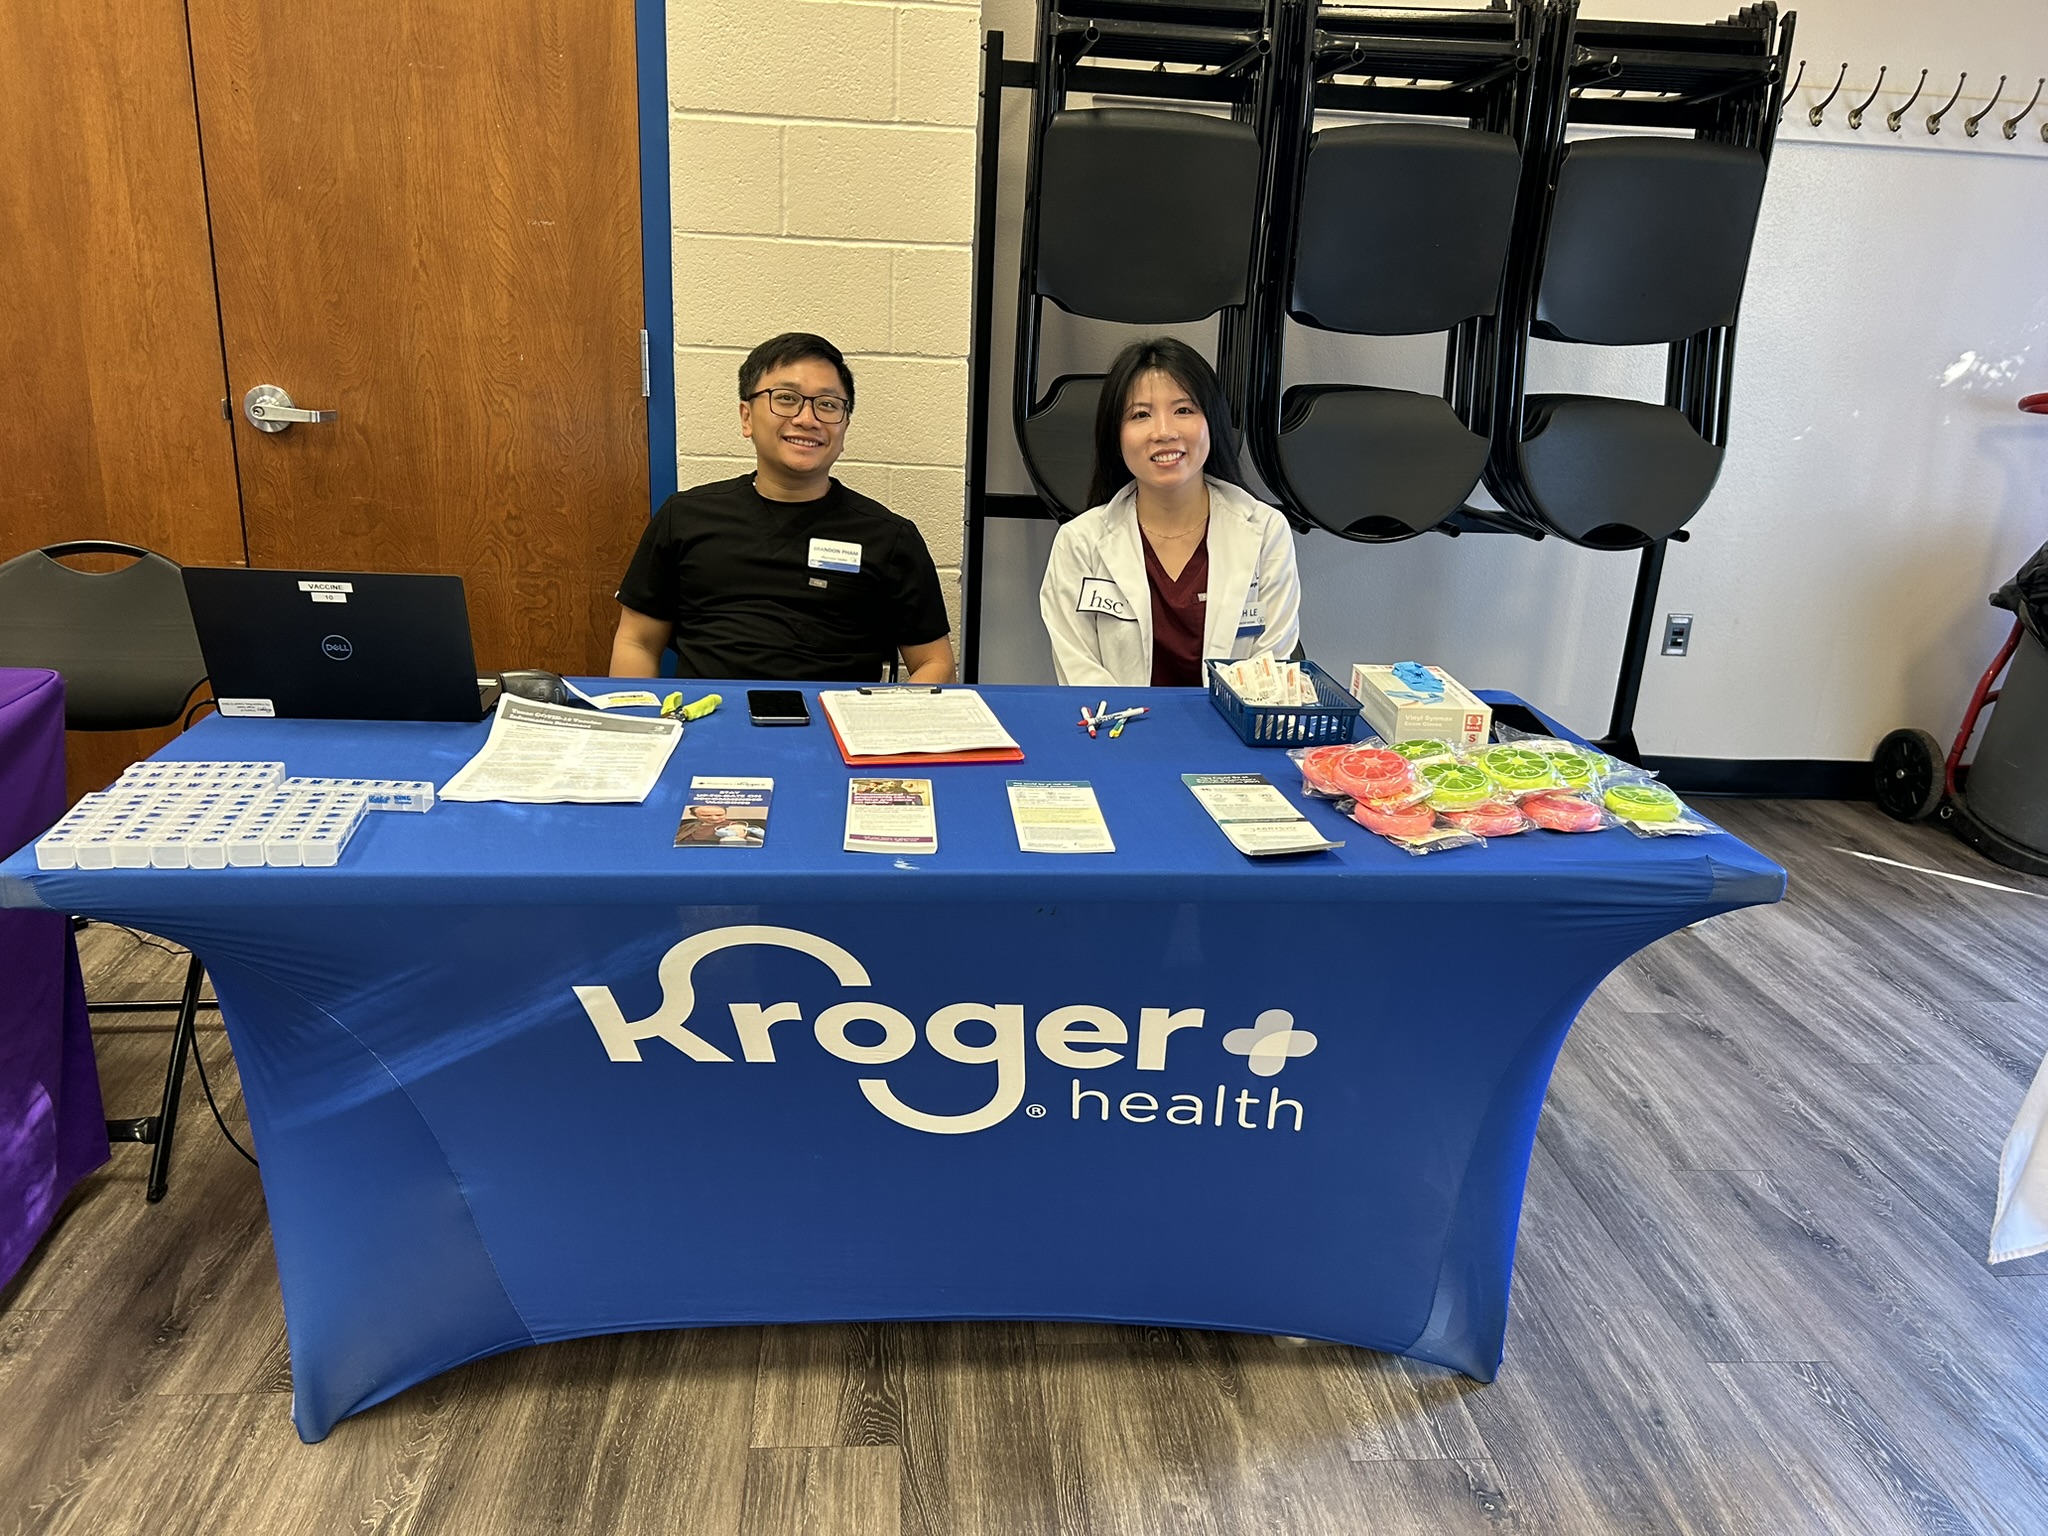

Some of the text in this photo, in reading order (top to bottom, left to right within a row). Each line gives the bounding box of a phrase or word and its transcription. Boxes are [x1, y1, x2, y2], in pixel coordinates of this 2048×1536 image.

[1089, 590, 1124, 614] hsc
[1250, 608, 1258, 616] LE
[326, 644, 350, 652] DELL
[534, 712, 572, 722] COVID-19
[1468, 734, 1476, 742] S
[572, 925, 1205, 1134] Kroger
[1072, 1079, 1304, 1131] health
